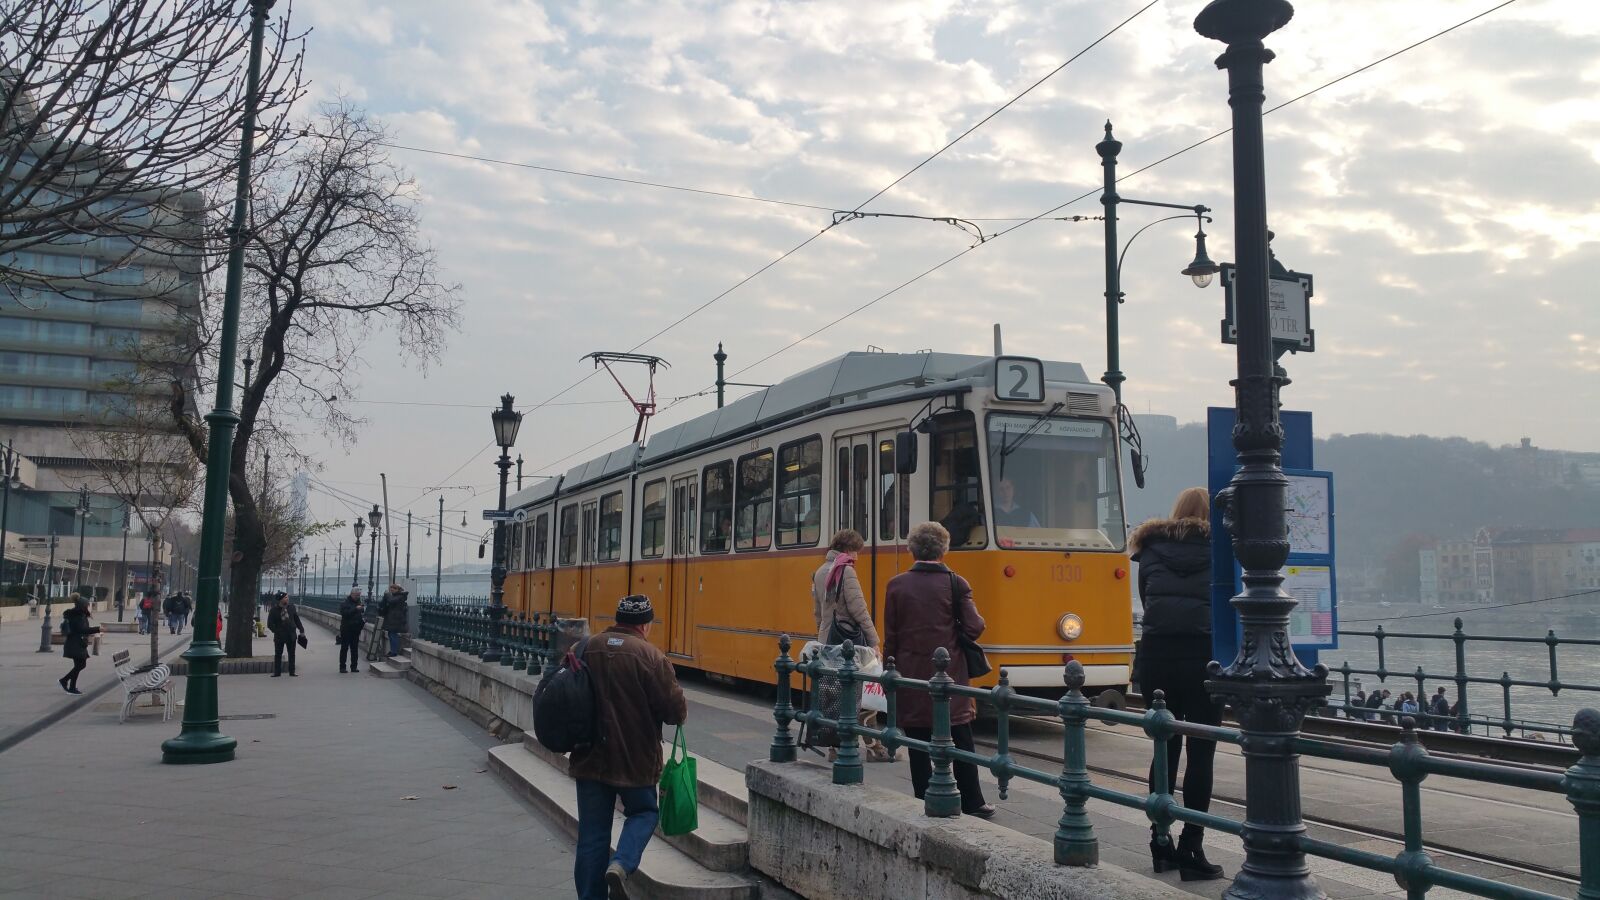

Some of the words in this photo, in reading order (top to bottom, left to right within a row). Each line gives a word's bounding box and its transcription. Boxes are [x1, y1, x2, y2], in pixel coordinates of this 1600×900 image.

[1008, 364, 1030, 398] 2
[1043, 422, 1053, 434] 2
[1050, 564, 1083, 583] 1330
